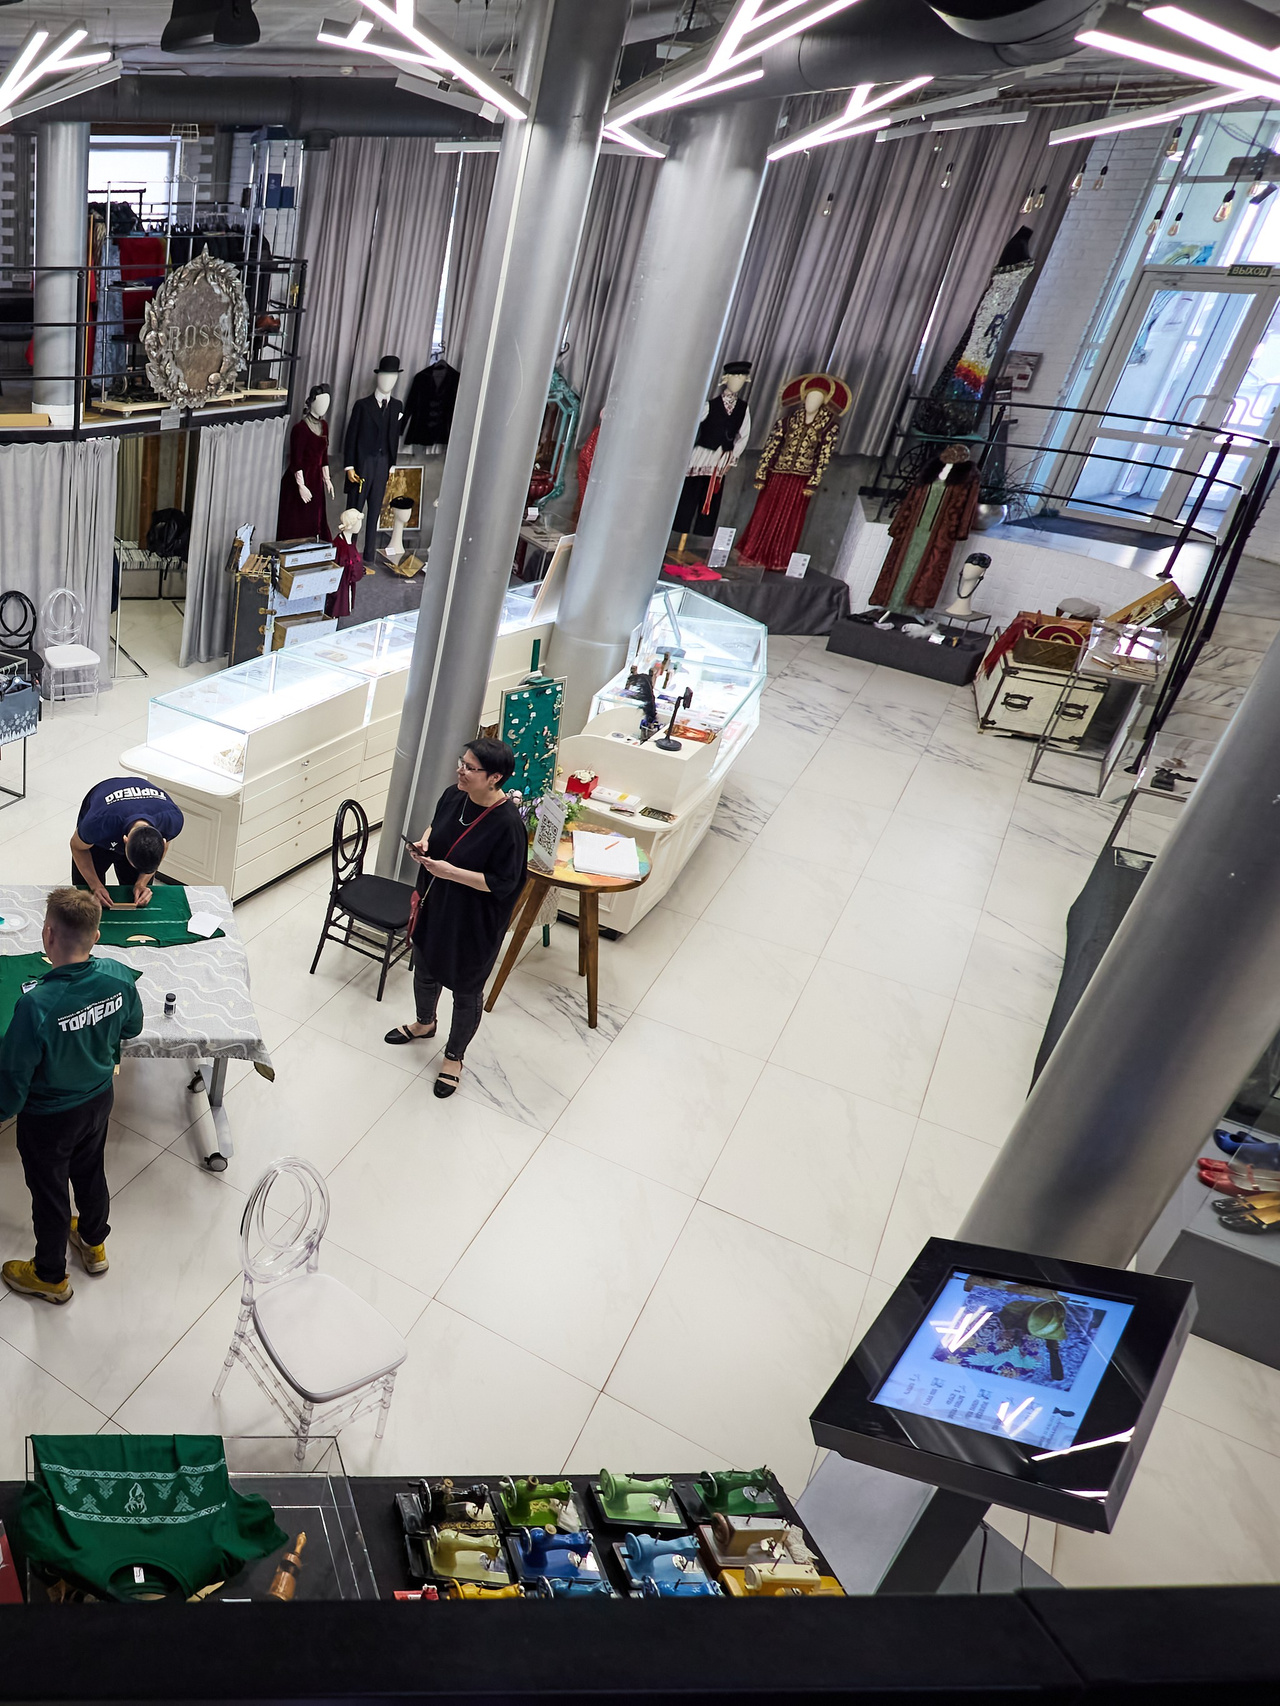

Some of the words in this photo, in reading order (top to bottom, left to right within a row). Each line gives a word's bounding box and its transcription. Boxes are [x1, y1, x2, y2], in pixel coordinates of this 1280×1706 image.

[1232, 266, 1269, 277] ВЫХОД
[105, 786, 167, 803] ТОРПЕДО
[58, 996, 123, 1032] ТОРПЕДО
